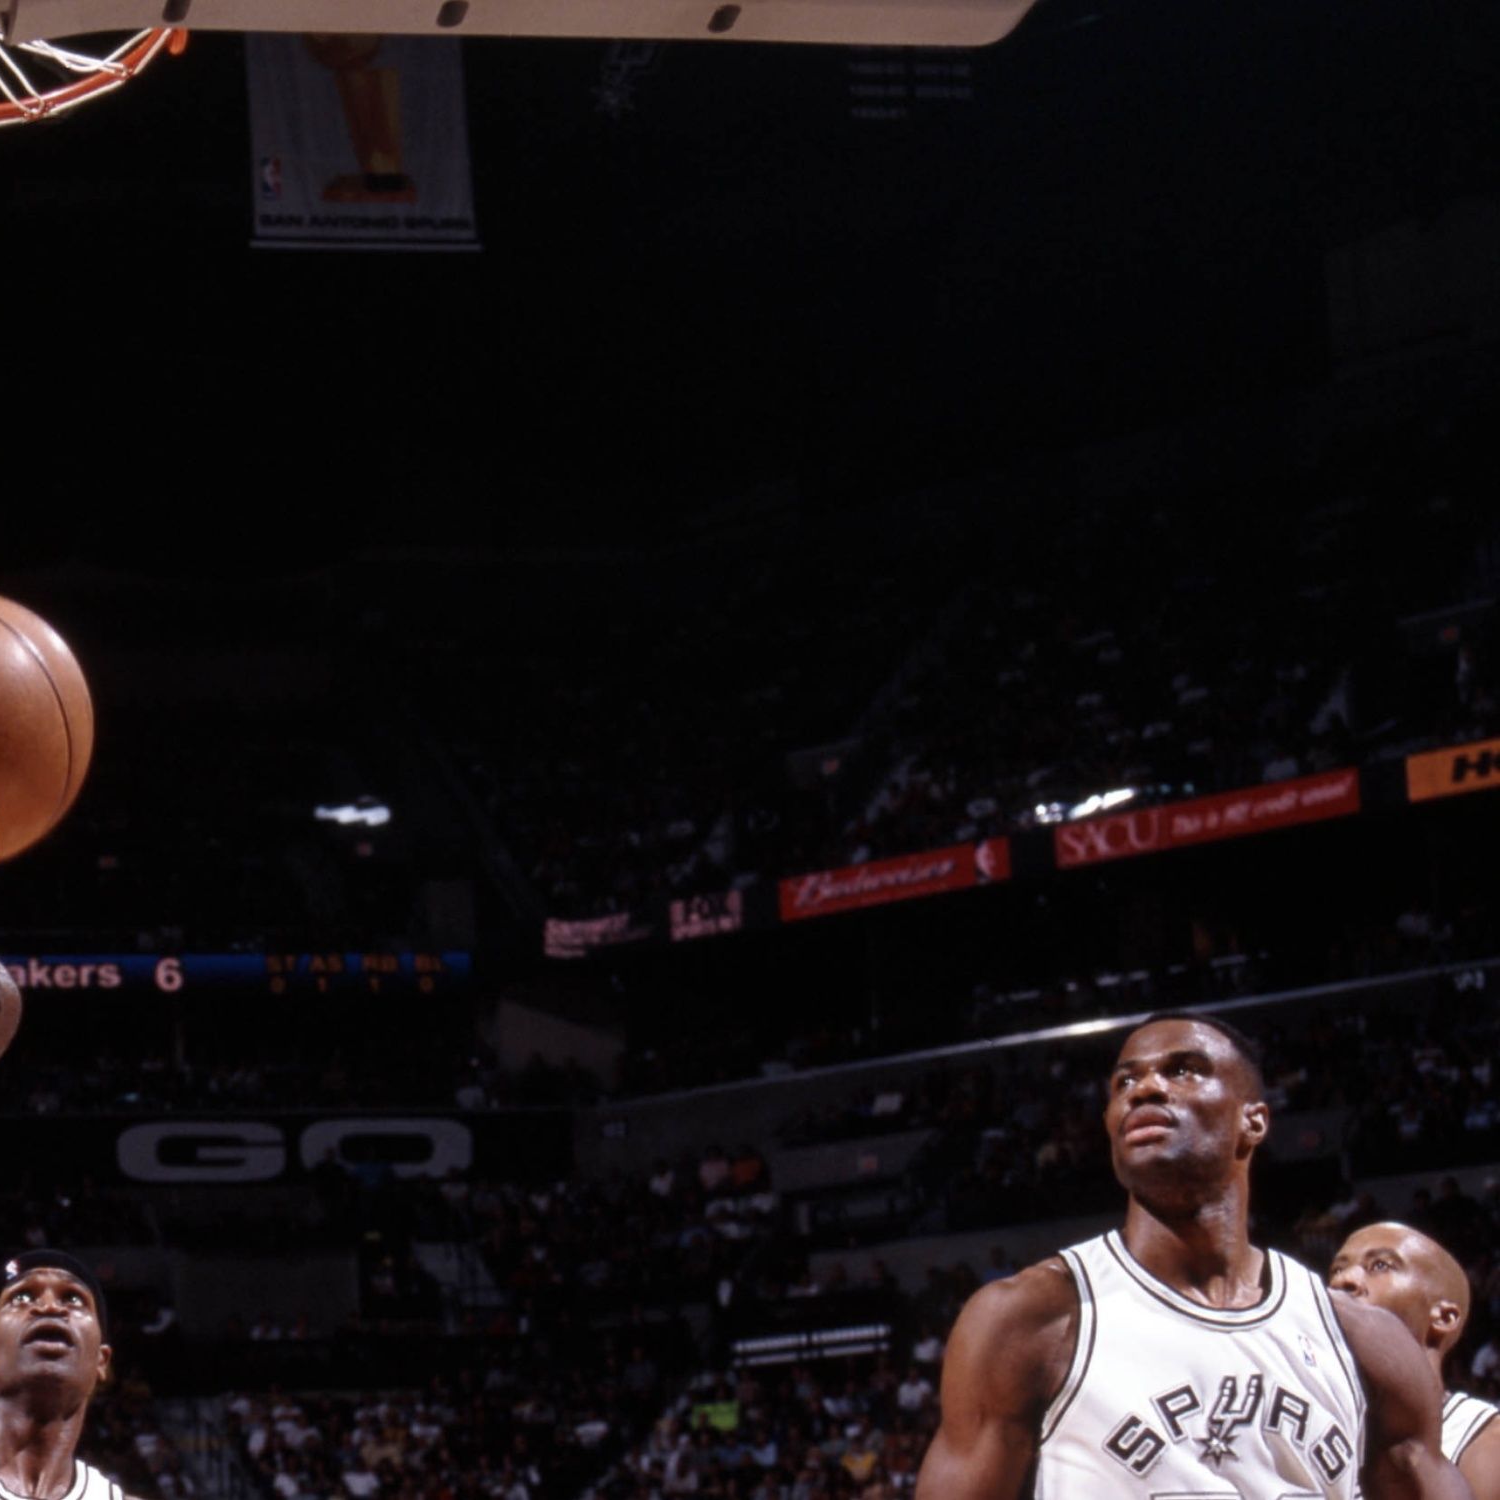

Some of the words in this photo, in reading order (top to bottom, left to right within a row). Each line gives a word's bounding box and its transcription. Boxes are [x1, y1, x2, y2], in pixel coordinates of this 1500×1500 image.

[1061, 807, 1163, 861] SACU
[155, 957, 183, 993] 6
[116, 1117, 472, 1184] GO
[1104, 1374, 1353, 1485] SPURS
